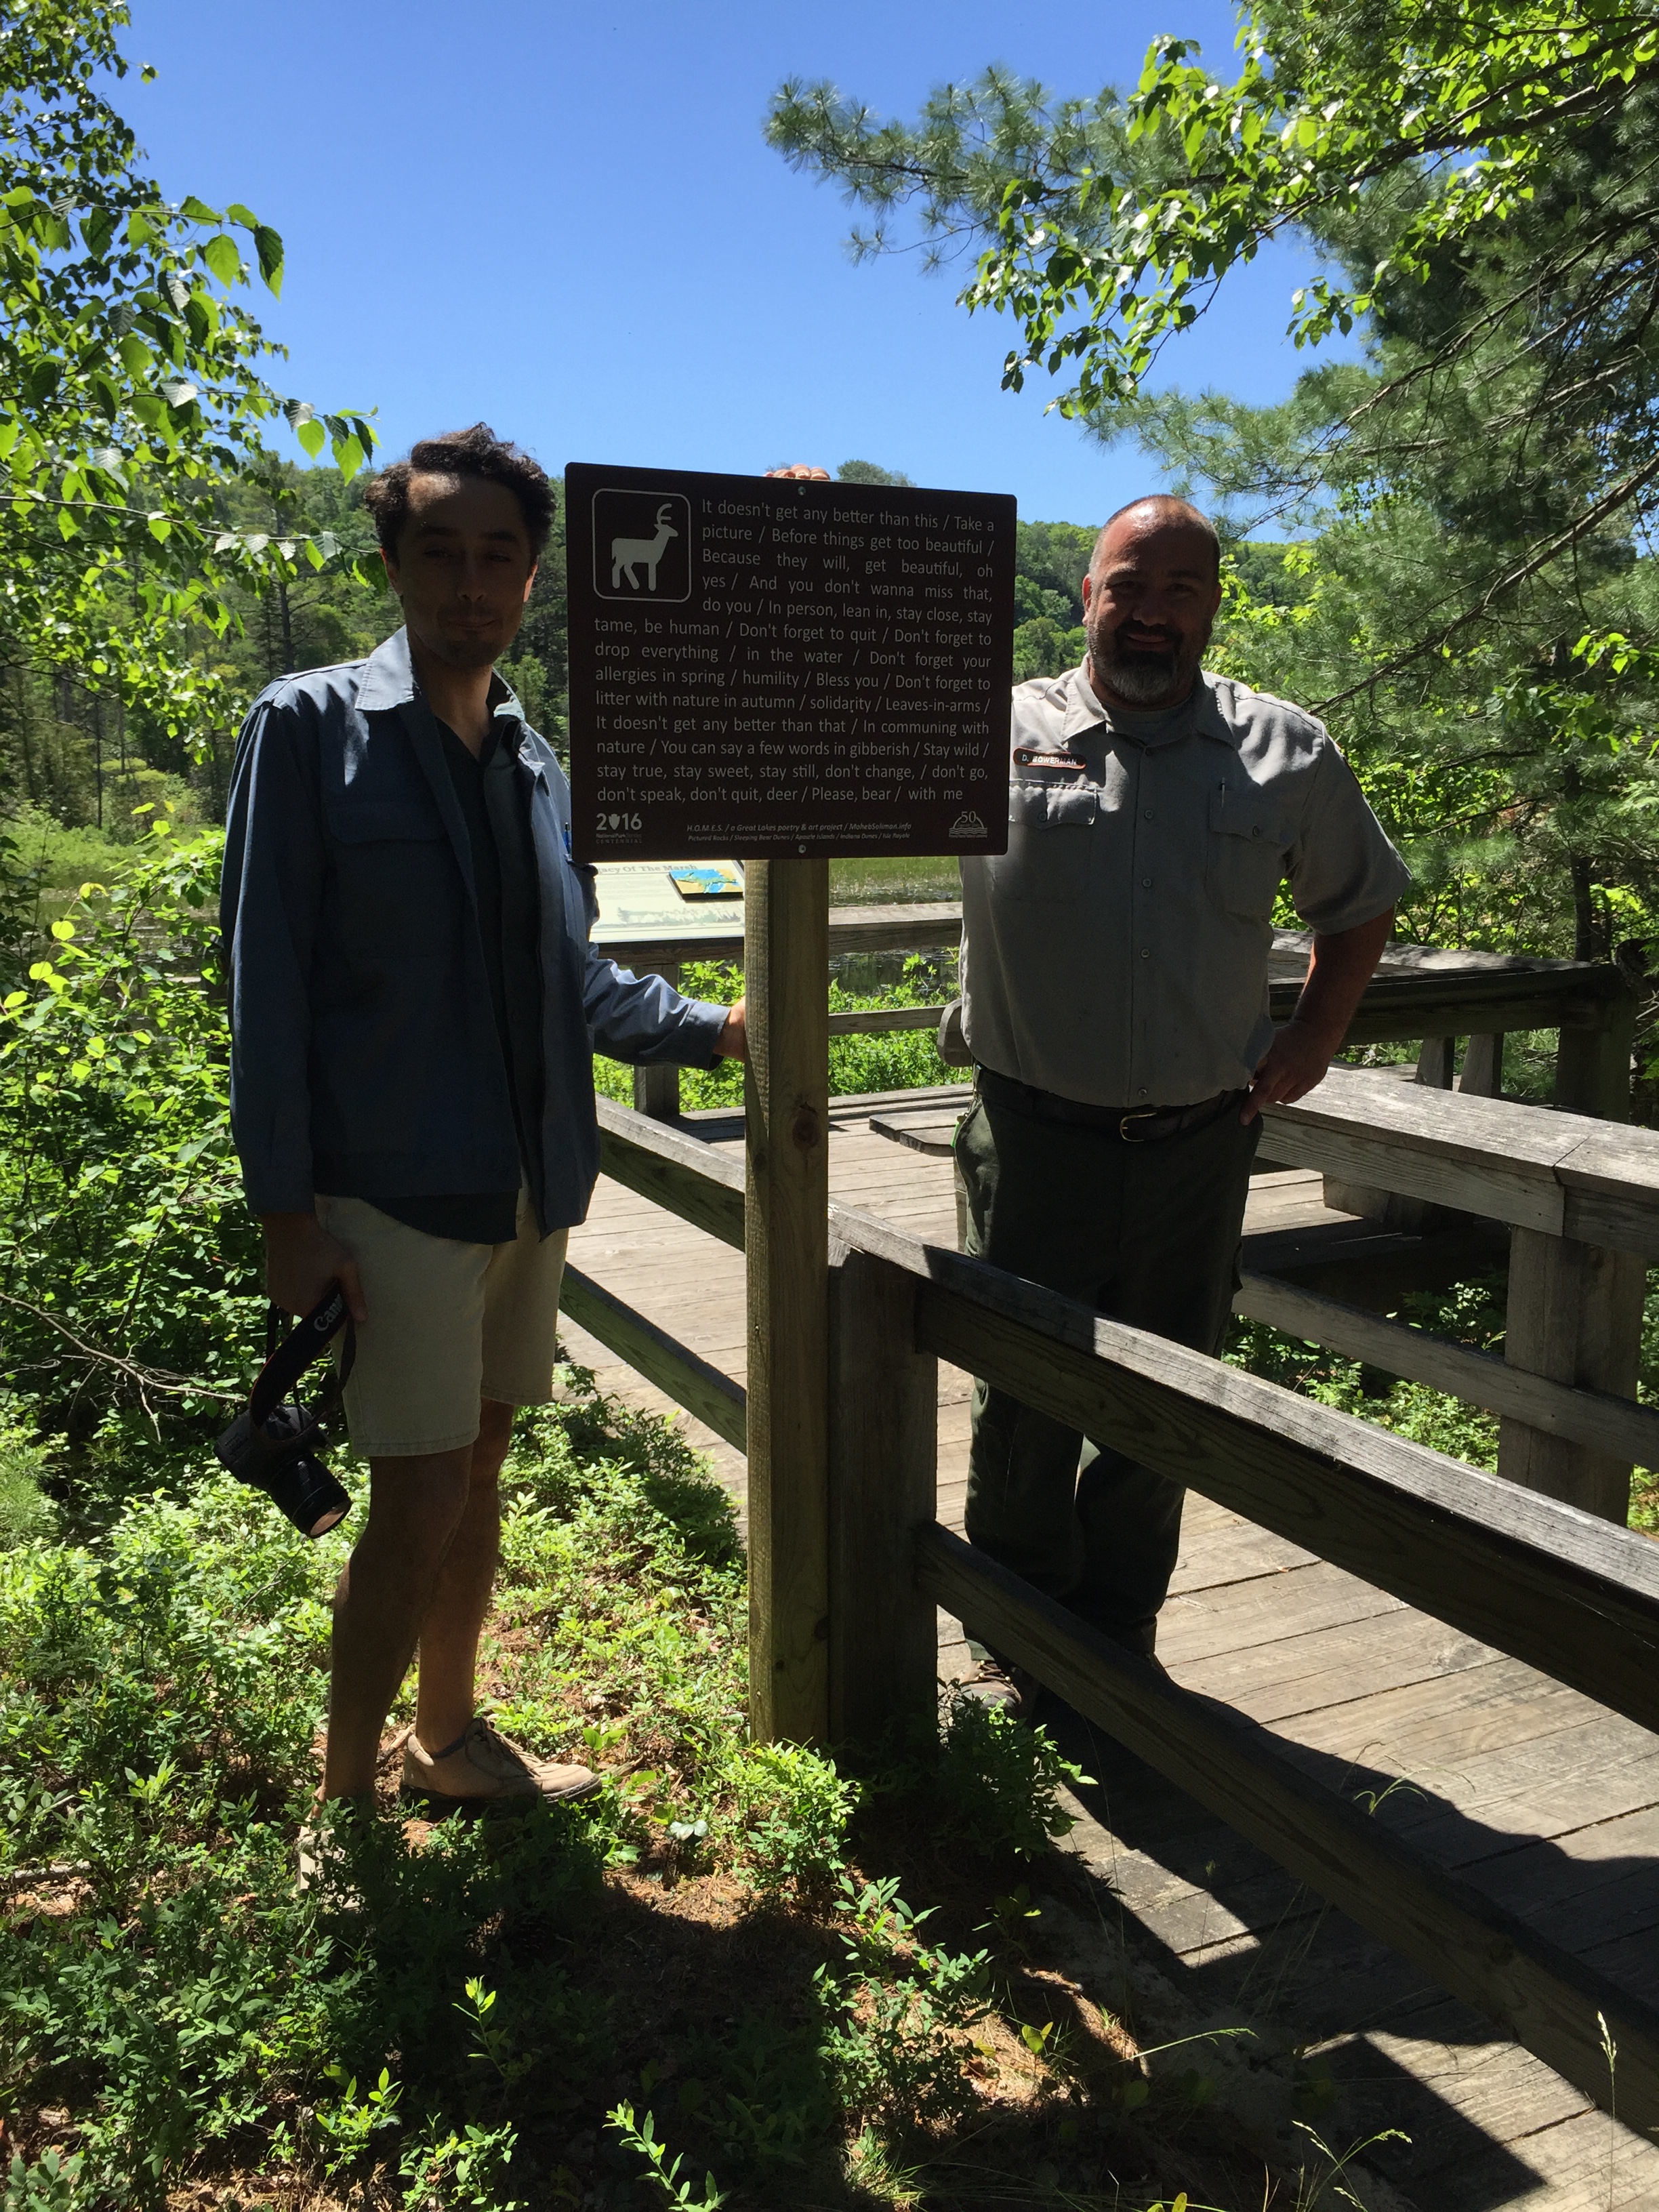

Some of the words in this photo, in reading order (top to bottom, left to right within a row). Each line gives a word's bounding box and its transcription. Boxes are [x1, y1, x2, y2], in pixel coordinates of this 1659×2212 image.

[703, 499, 712, 512] It
[718, 499, 770, 516] doesn't
[776, 506, 797, 520] get
[804, 509, 827, 523] any
[834, 507, 874, 523] better
[880, 510, 909, 526] than
[914, 513, 937, 527] this
[943, 514, 949, 531] /
[954, 516, 981, 531] Take
[987, 521, 994, 531] a
[703, 524, 752, 540] picture
[758, 526, 765, 543] /
[773, 528, 816, 544] Before
[823, 531, 864, 550] things
[870, 536, 891, 551] get
[897, 537, 919, 550] too
[926, 537, 981, 553] beautiful
[987, 540, 994, 556] /
[703, 548, 760, 565] Because
[777, 552, 807, 570] they
[823, 555, 849, 572] will,
[865, 559, 886, 574] get
[901, 559, 962, 577] beautiful,
[977, 563, 992, 577] oh
[702, 576, 725, 590] yes
[731, 573, 738, 590] /
[750, 575, 776, 590] And
[788, 581, 813, 594] you
[825, 579, 859, 594] don't
[870, 585, 914, 596] wanna
[925, 585, 952, 598] miss
[963, 586, 991, 602] that,
[703, 597, 720, 611] do
[726, 602, 751, 615] you
[756, 598, 763, 615] /
[769, 600, 781, 613] In
[787, 604, 836, 619] person,
[843, 603, 869, 617] lean
[876, 605, 890, 621] in,
[897, 607, 922, 623] stay
[926, 607, 962, 623] close,
[967, 611, 991, 626] stay
[594, 618, 636, 634] tame,
[645, 618, 662, 633] be
[670, 619, 718, 635] human
[726, 621, 733, 638] /
[740, 623, 777, 637] Don't
[783, 623, 823, 642] forget
[830, 628, 844, 640] to
[851, 628, 876, 643] quit
[895, 629, 929, 642] Don't
[935, 630, 972, 647] forget
[979, 633, 991, 644] to
[595, 641, 629, 659] drop
[642, 644, 718, 662] everything
[747, 647, 758, 660] in
[771, 647, 793, 661] the
[804, 651, 842, 663] water
[870, 651, 905, 665] Don't
[915, 651, 953, 669] forget
[963, 657, 991, 670] your
[596, 665, 656, 684] allergies
[663, 668, 674, 682] in
[682, 670, 724, 687] spring
[743, 670, 799, 688] humility
[817, 672, 849, 686] Bless
[855, 677, 878, 690] you
[896, 675, 930, 689] Don't
[935, 675, 972, 692] forget
[977, 678, 990, 690] to
[596, 690, 631, 705] litter
[636, 691, 667, 705] with
[673, 694, 719, 707] nature
[724, 693, 736, 707] in
[741, 695, 794, 708] autumn
[811, 695, 871, 712] solidarity
[886, 697, 980, 712] Leaves-in-arms
[596, 715, 606, 729] It
[613, 715, 667, 729] doesn't
[674, 718, 696, 733] get
[703, 720, 727, 733] any
[734, 716, 775, 731] better
[781, 718, 812, 731] than
[819, 718, 845, 732] that
[864, 720, 875, 732] In
[881, 721, 956, 737] communing
[962, 721, 989, 733] with
[597, 741, 644, 753] nature
[661, 740, 686, 754] You
[691, 743, 715, 754] can
[720, 744, 742, 757] say
[747, 744, 754, 754] a
[760, 740, 784, 754] few
[788, 741, 829, 754] words
[834, 741, 845, 754] in
[850, 741, 909, 758] gibberish
[923, 743, 949, 758] Stay
[954, 742, 979, 756] wild
[1021, 754, 1029, 762] D.
[1032, 755, 1077, 766] BOWERMAN
[597, 764, 626, 780] stay
[632, 764, 666, 779] true,
[674, 765, 701, 780] stay
[708, 765, 752, 779] sweet,
[760, 765, 786, 781] stay
[792, 764, 819, 779] still,
[825, 764, 859, 777] don't
[865, 764, 914, 781] change,
[932, 764, 964, 778] don't
[970, 768, 987, 781] go,
[598, 787, 635, 800] don't
[640, 787, 685, 804] speak,
[691, 787, 726, 800] don't
[731, 787, 762, 803] quit,
[766, 787, 798, 800] deer
[813, 787, 857, 802] Please,
[862, 786, 891, 800] bear
[908, 787, 935, 800] with
[943, 790, 962, 800] me
[737, 823, 756, 832] Great
[758, 823, 777, 832] Lakes
[777, 824, 800, 834] poetry
[808, 823, 819, 832] art
[819, 823, 843, 832] project
[960, 811, 977, 823] 50
